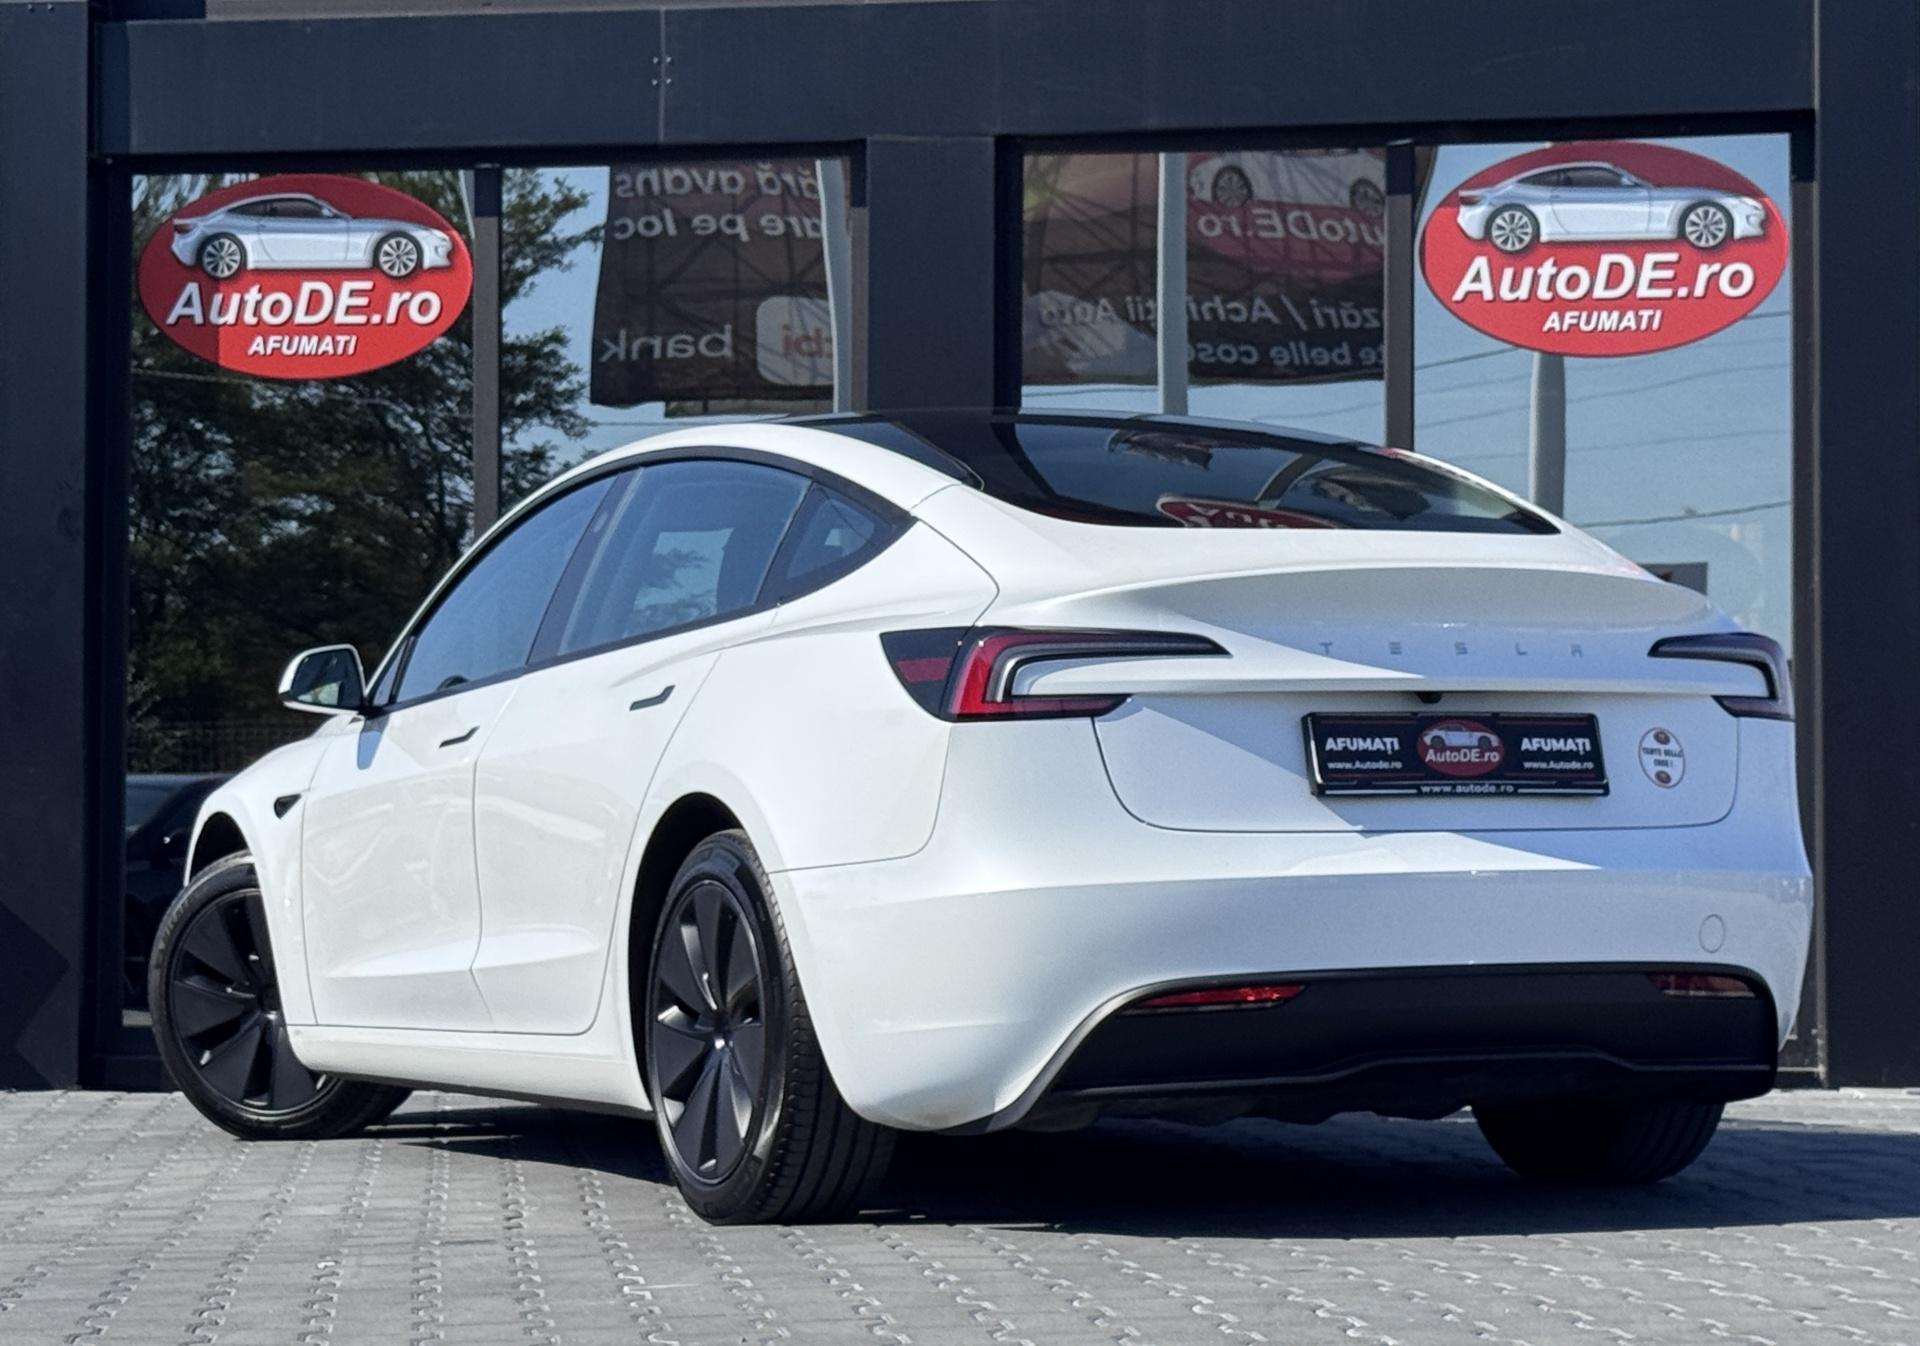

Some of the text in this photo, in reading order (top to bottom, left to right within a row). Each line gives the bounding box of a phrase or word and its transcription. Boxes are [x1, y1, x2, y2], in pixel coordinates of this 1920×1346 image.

[1452, 252, 1755, 302] AutoDE.ro
[165, 280, 442, 326] AutoDE.ro
[1542, 309, 1662, 332] AFUMATI
[248, 335, 357, 356] AFUMATI
[1319, 642, 1583, 657] TESLA
[1425, 748, 1500, 763] AutoDE.ro
[1420, 784, 1514, 793] www.autode.ro
